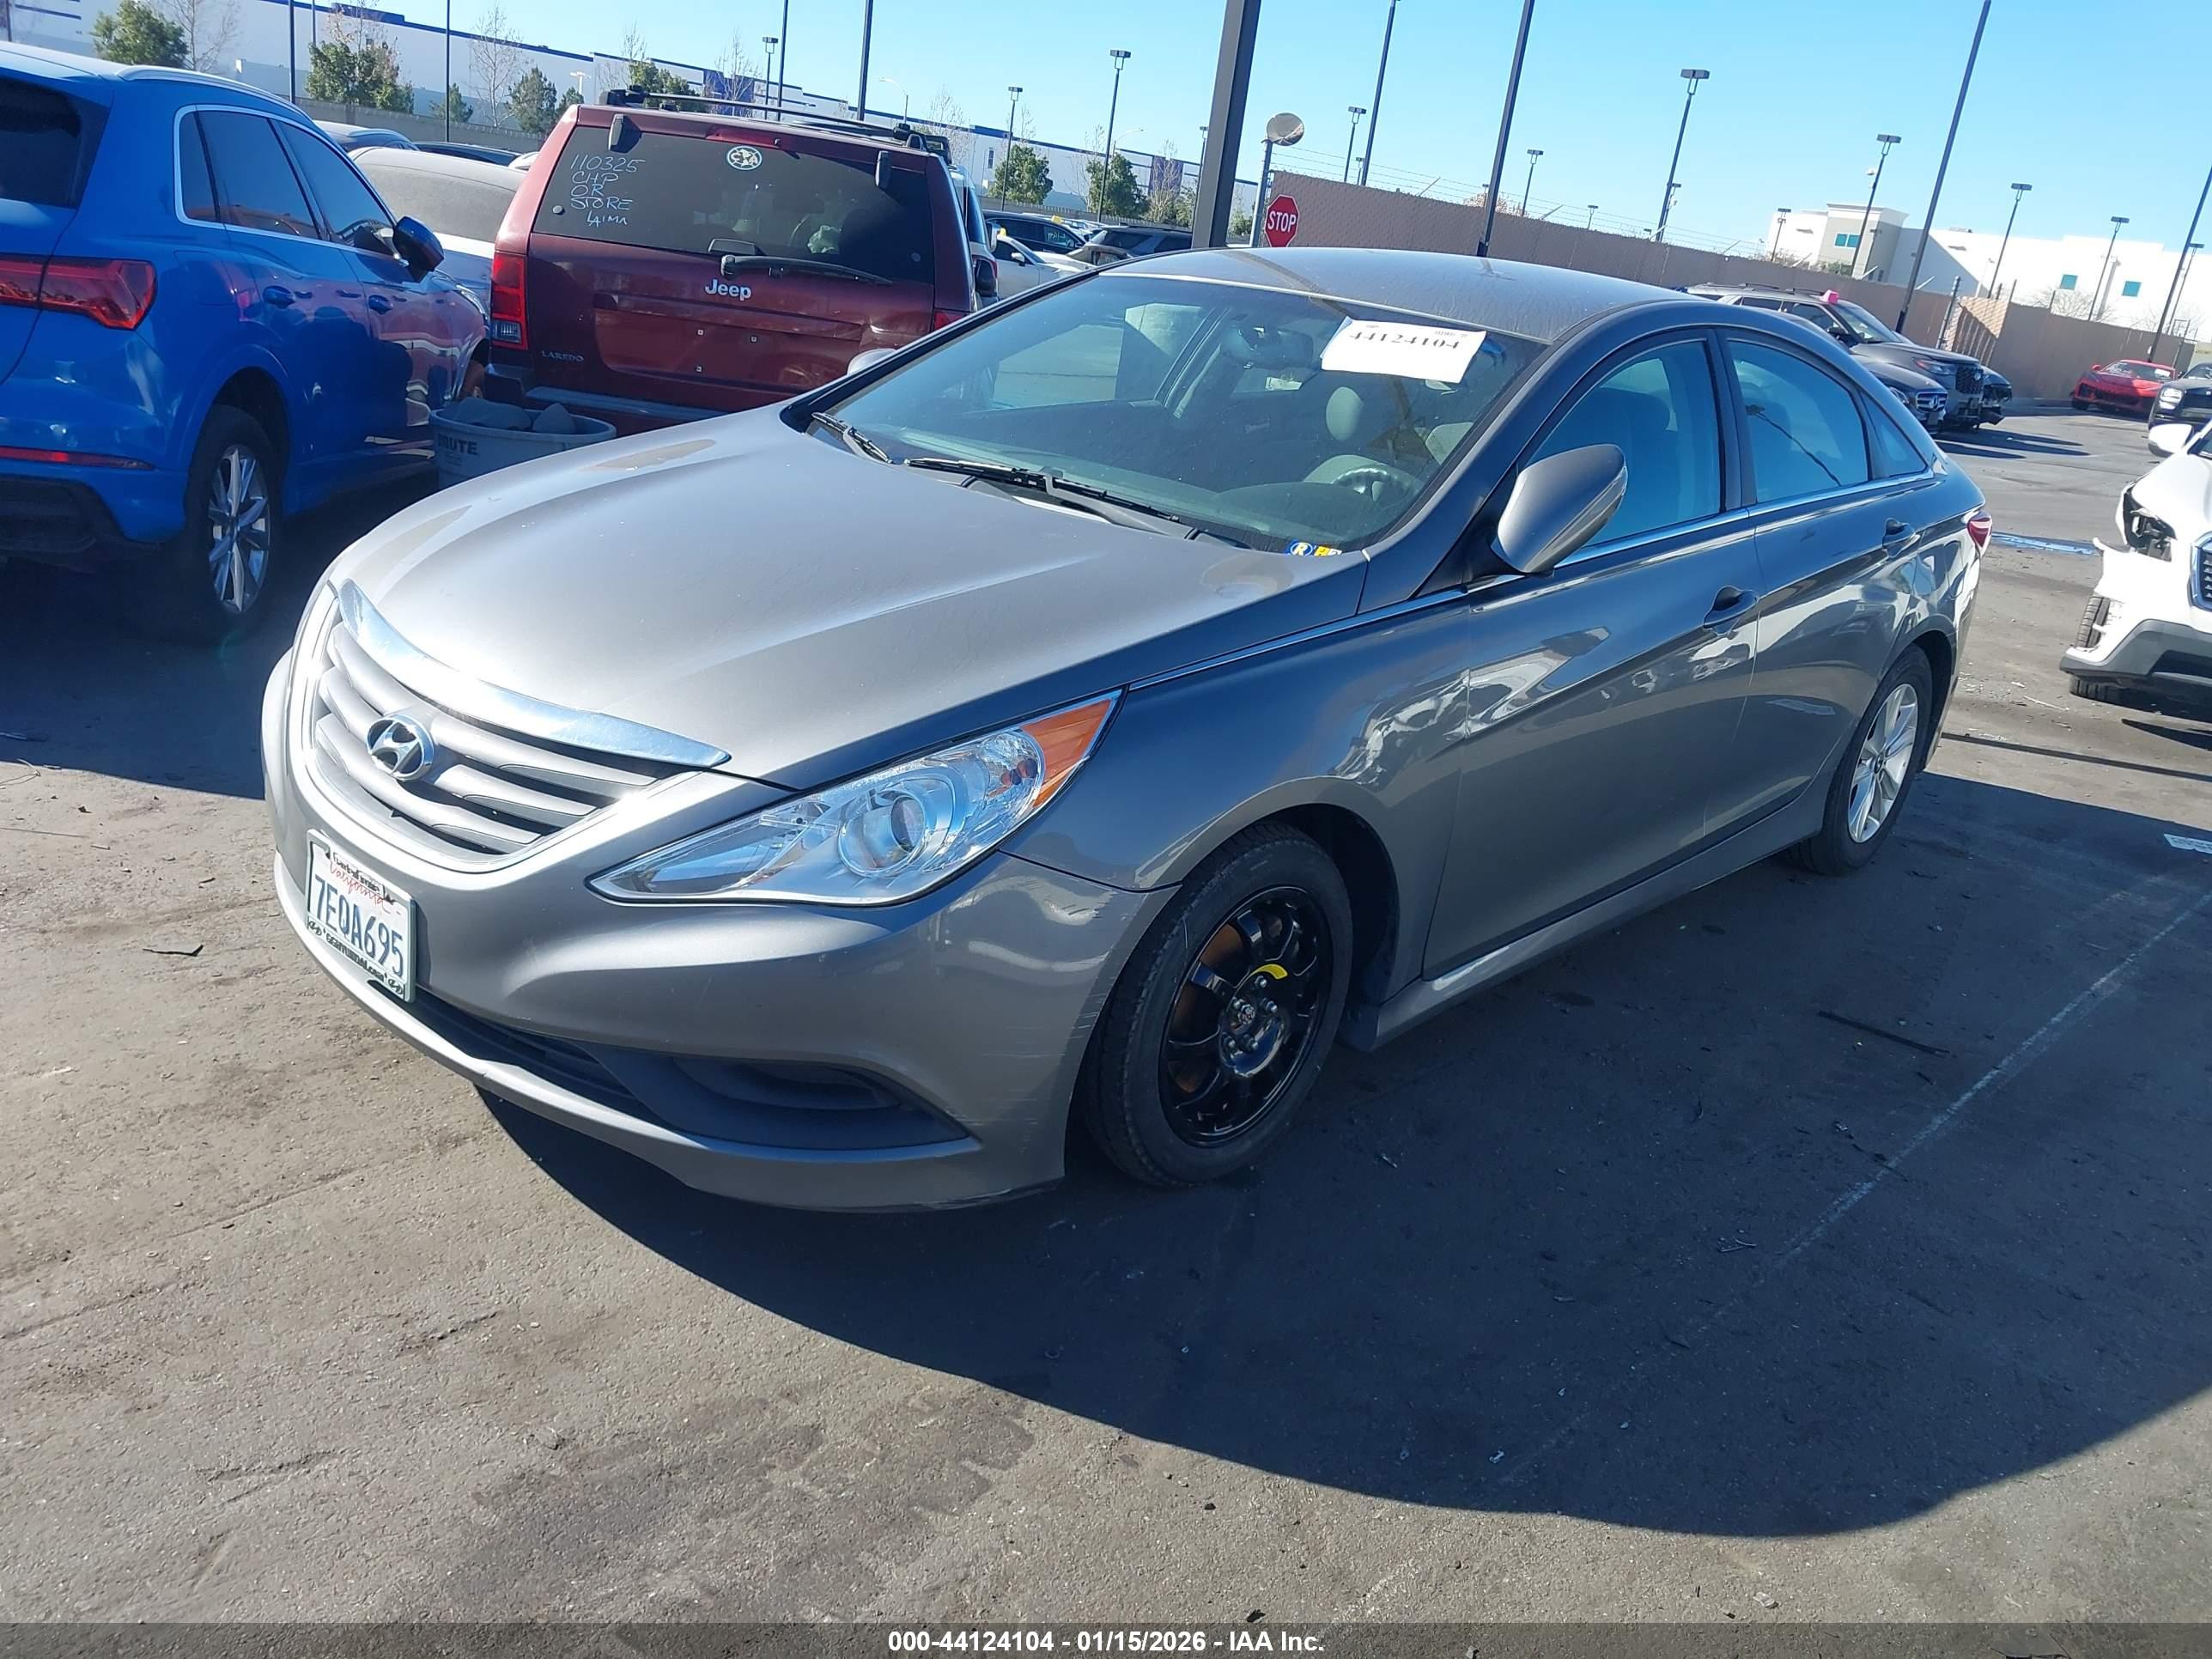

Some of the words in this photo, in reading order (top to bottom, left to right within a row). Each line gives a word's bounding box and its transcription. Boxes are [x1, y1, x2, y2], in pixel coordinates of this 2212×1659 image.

[570, 155, 646, 172] 110325
[572, 171, 618, 185] CHP
[571, 184, 605, 197] OR
[571, 197, 633, 210] STORE
[1267, 210, 1297, 233] STOP
[705, 278, 751, 301] Jeep
[1349, 331, 1460, 349] 44124104
[542, 350, 584, 362] LAREDO
[315, 874, 404, 978] 7EQA695
